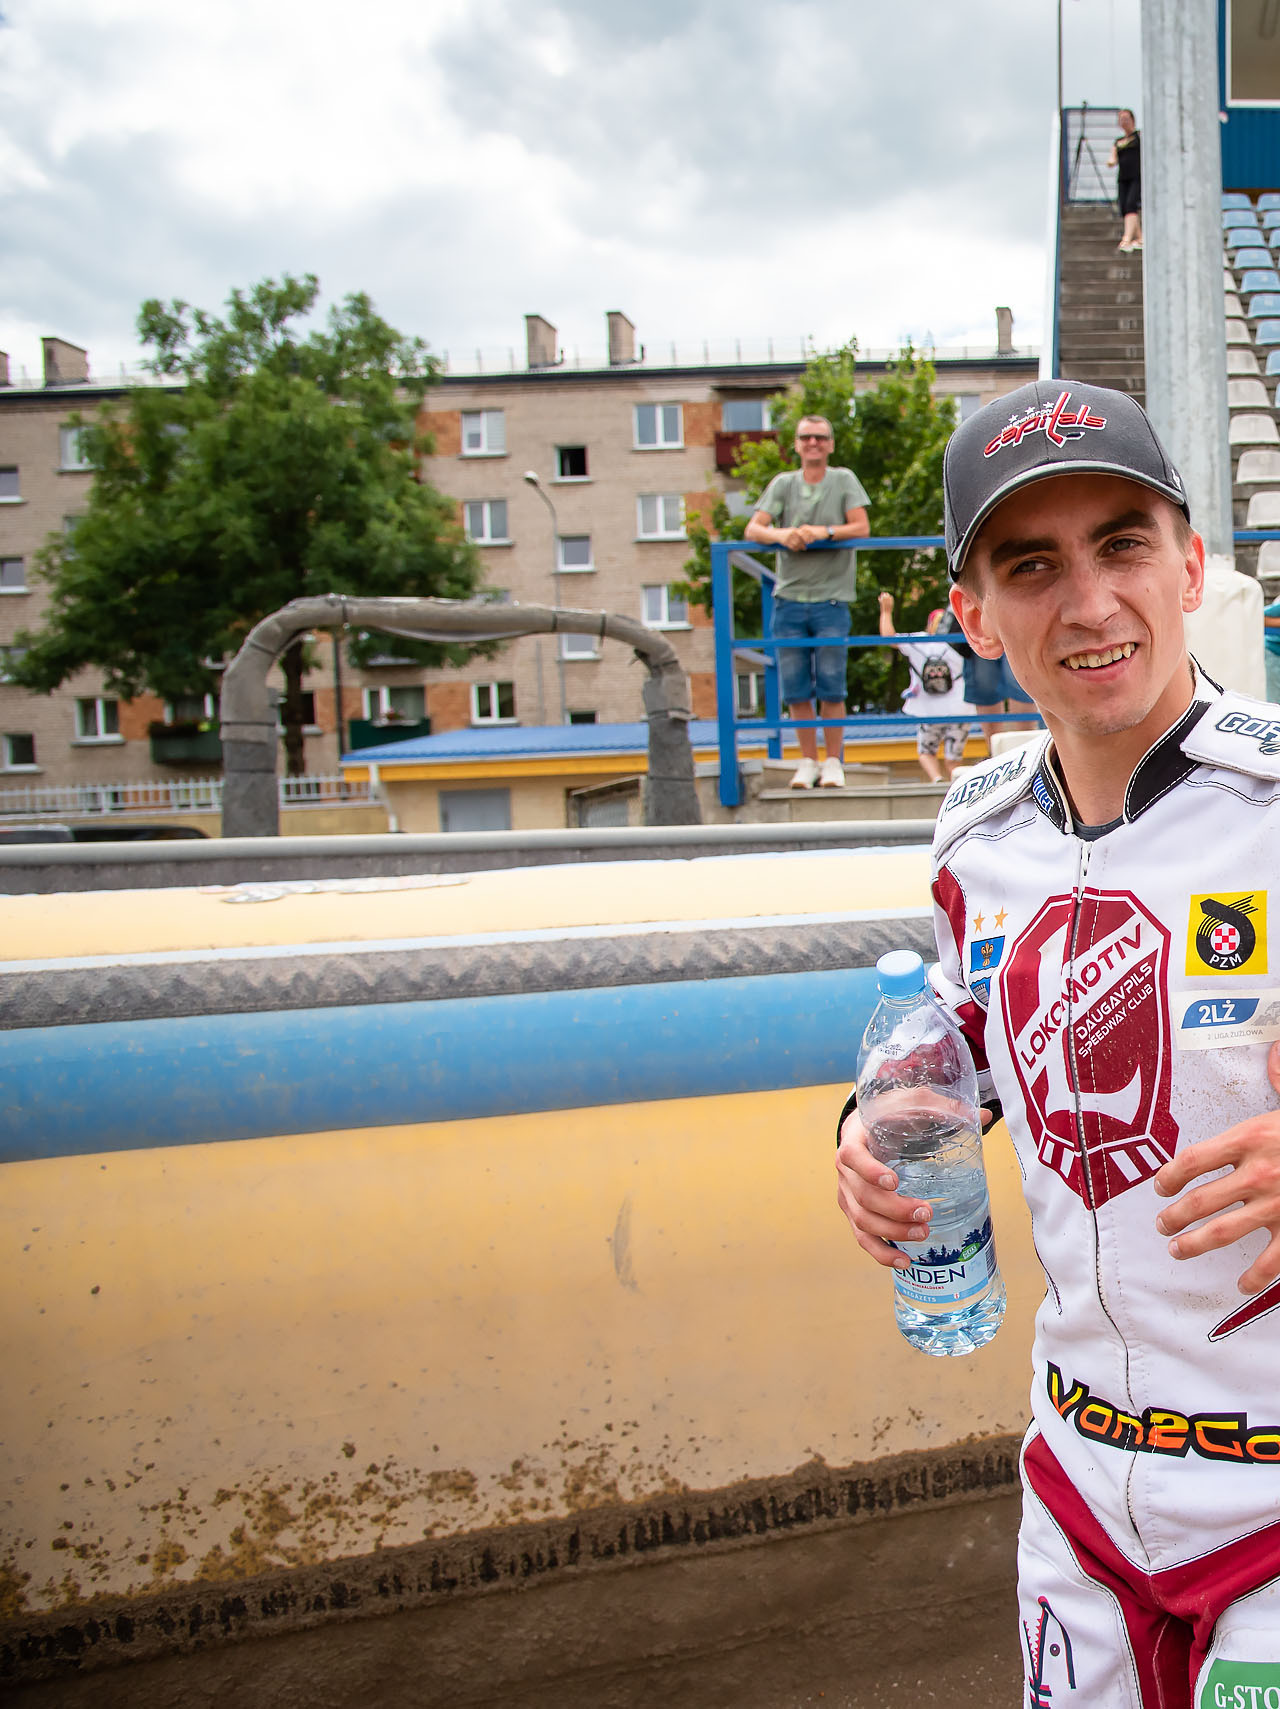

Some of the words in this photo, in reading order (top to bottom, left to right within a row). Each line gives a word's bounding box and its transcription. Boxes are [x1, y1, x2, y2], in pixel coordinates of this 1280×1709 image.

[1020, 922, 1142, 1070] LOKOMOTIV
[1209, 953, 1243, 969] PZM
[1075, 961, 1154, 1041] DAUGAVPILS
[1078, 1006, 1129, 1059] SPEEDWAY
[1129, 983, 1155, 1010] CLUB
[1198, 1000, 1237, 1025] 2LŻ
